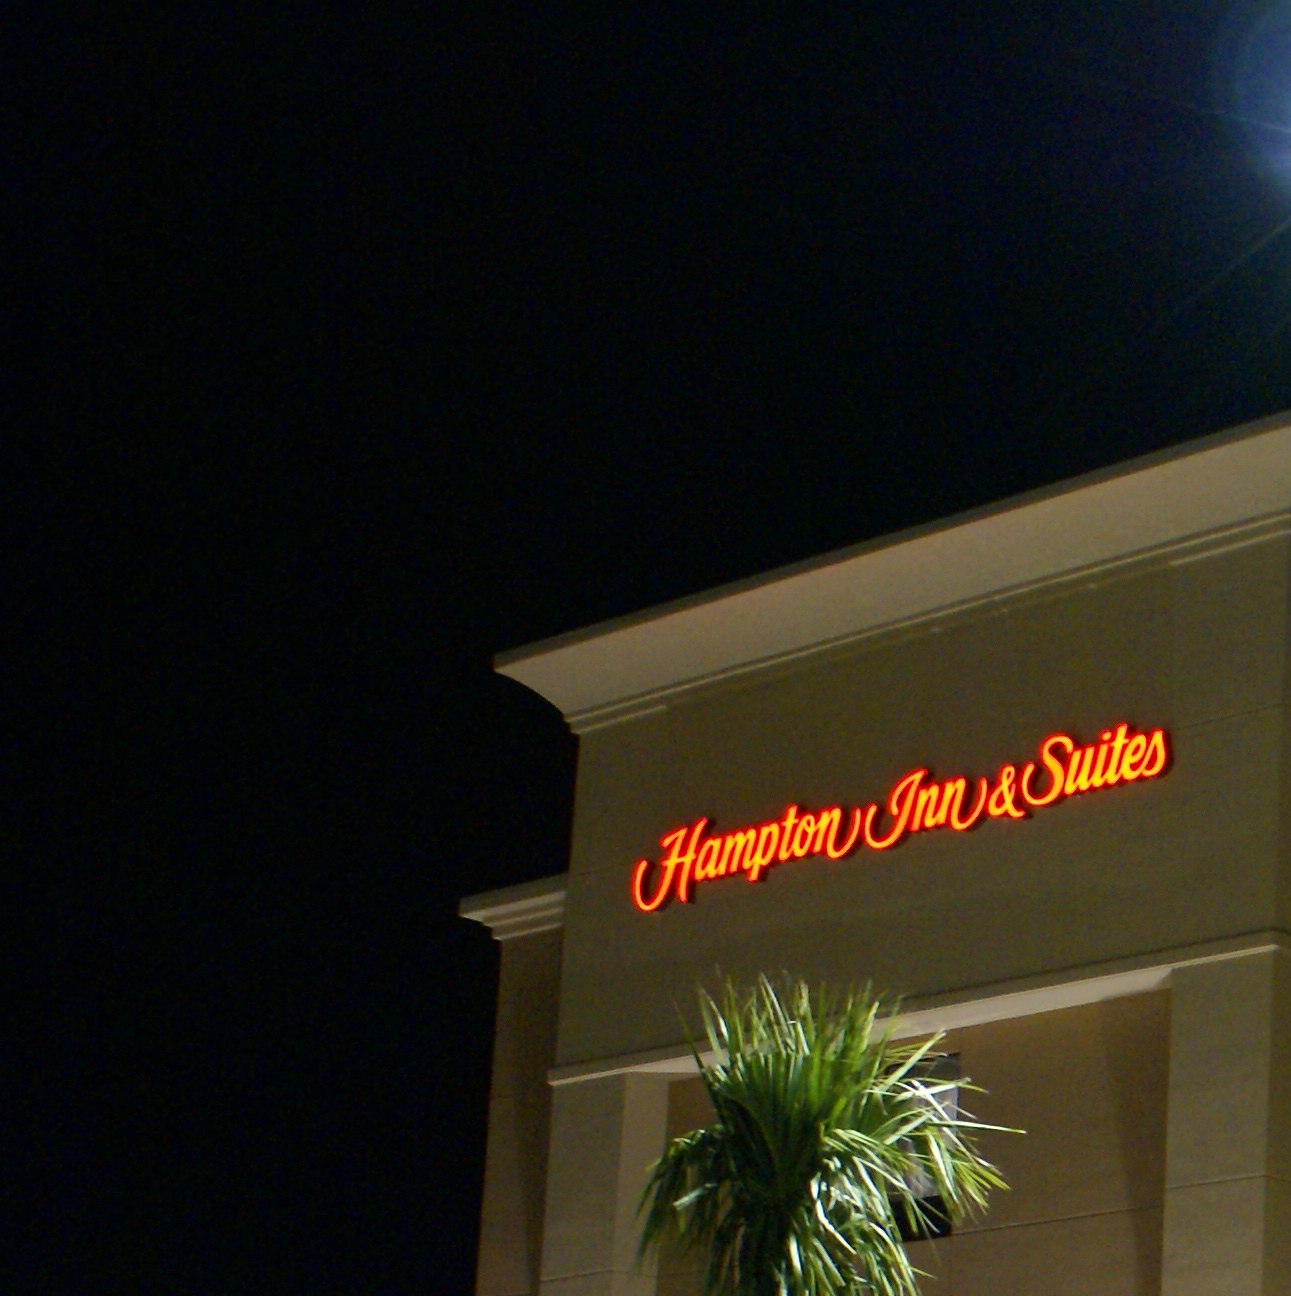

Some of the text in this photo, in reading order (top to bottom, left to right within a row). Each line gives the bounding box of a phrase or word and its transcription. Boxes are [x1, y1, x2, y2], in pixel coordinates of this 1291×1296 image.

[632, 722, 1168, 912] Hampton Inn & Suites
